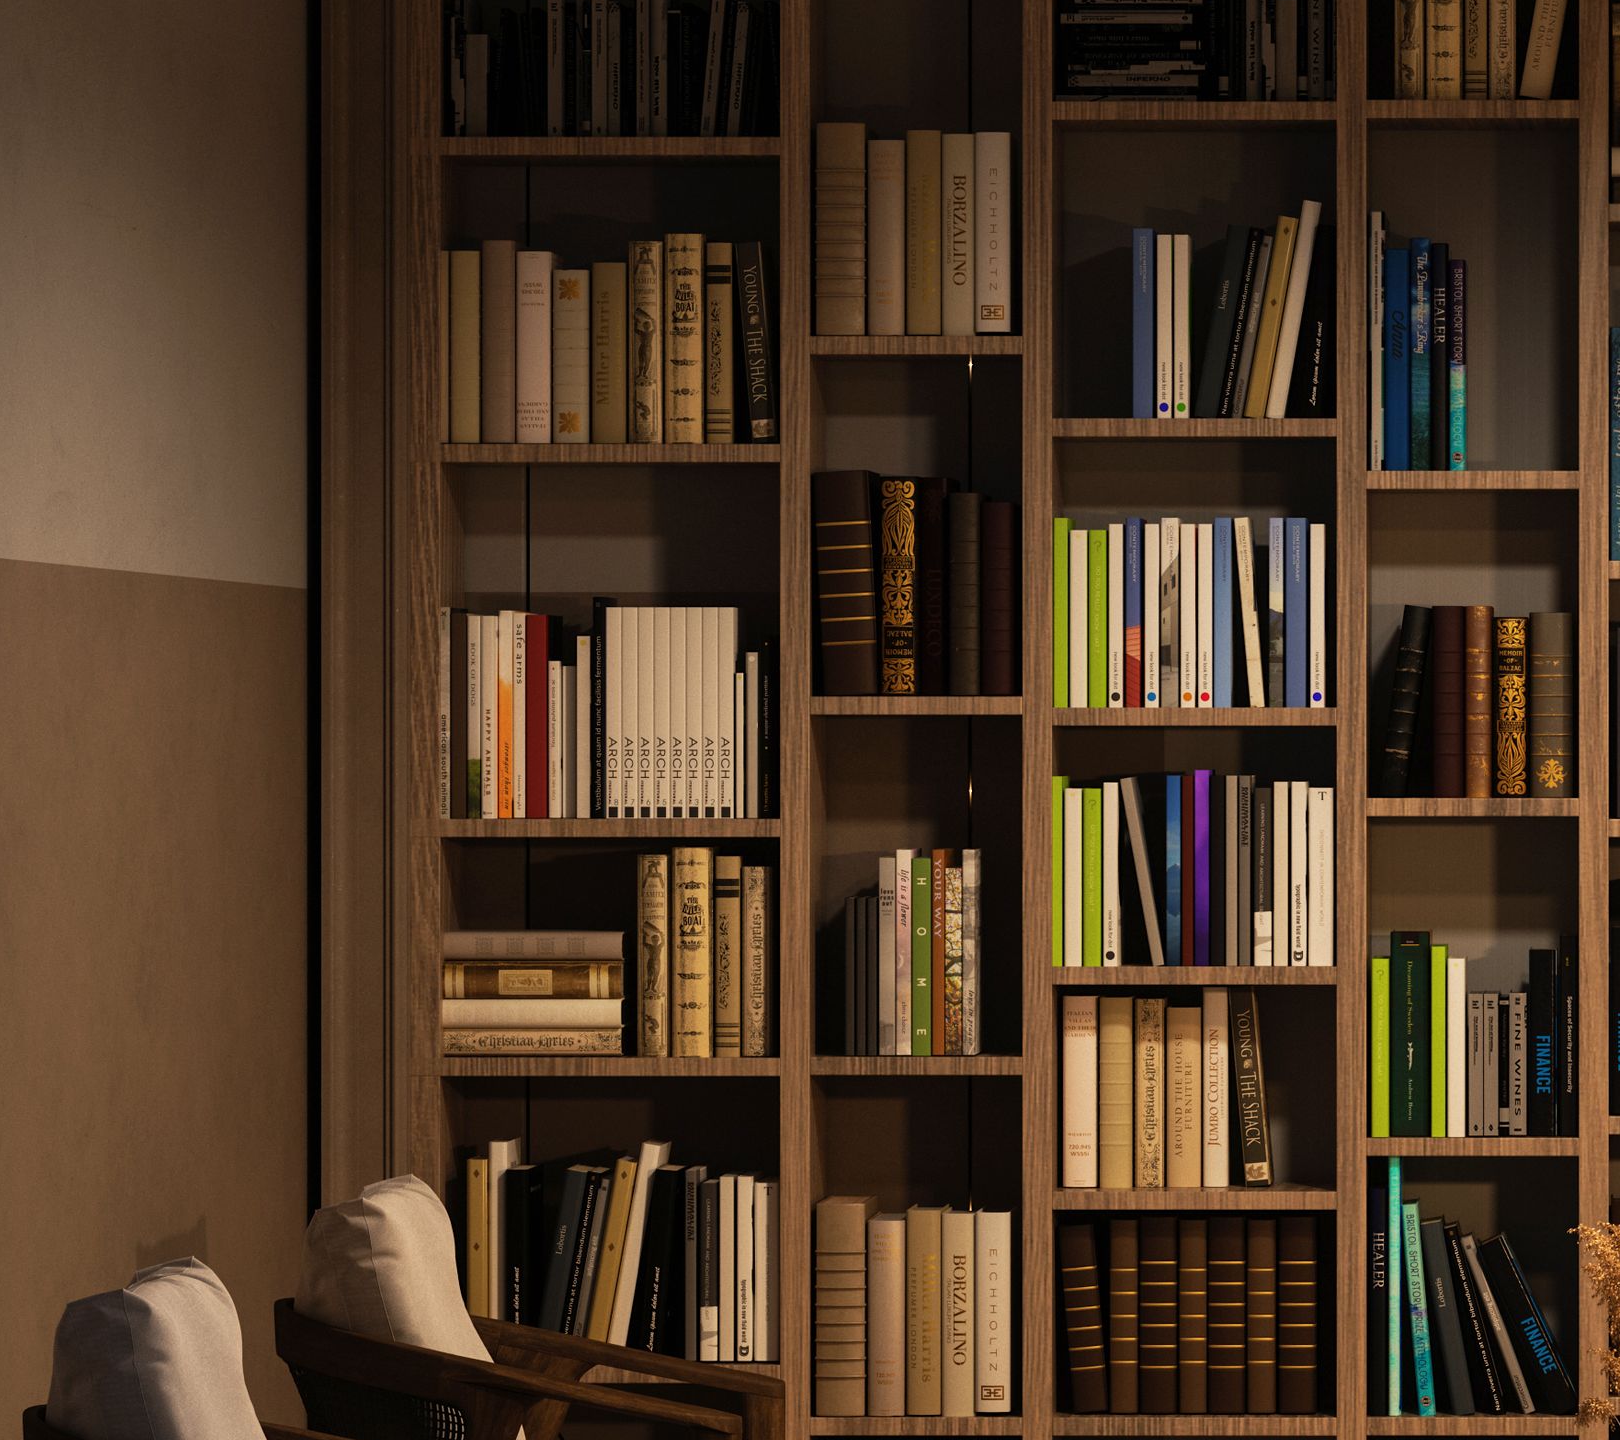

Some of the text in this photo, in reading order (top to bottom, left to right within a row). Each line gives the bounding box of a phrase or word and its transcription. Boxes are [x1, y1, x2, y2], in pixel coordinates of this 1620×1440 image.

[953, 175, 966, 285] BORZALINO
[989, 168, 998, 291] EICHHOLTZ
[1244, 241, 1256, 281] elementum
[1218, 280, 1229, 310] Lobortis
[1237, 283, 1249, 320] bibendum
[1434, 287, 1445, 344] HEALER
[596, 292, 609, 405] Miller Harris
[743, 265, 767, 403] YOUNG THE SHACK
[1233, 321, 1242, 342] tortor
[1392, 311, 1406, 359] Anna
[1224, 371, 1233, 395] viverra
[1228, 353, 1237, 369] urna
[1221, 398, 1229, 414] Nam
[516, 624, 525, 649] safe
[934, 859, 942, 937] YOUR WAY
[1175, 1033, 1183, 1072] HOUSE
[1237, 1010, 1261, 1147] YOUNG THE SHACK
[1536, 1035, 1551, 1094] FINANCE
[1207, 1029, 1221, 1146] JUMBO COLLECTION
[1175, 1107, 1183, 1157] AROUND
[1373, 1232, 1384, 1289] HEALER
[953, 1255, 966, 1365] BORZALINO
[989, 1249, 997, 1372] EICHHOLTZ
[1520, 1316, 1557, 1374] FINANCE
